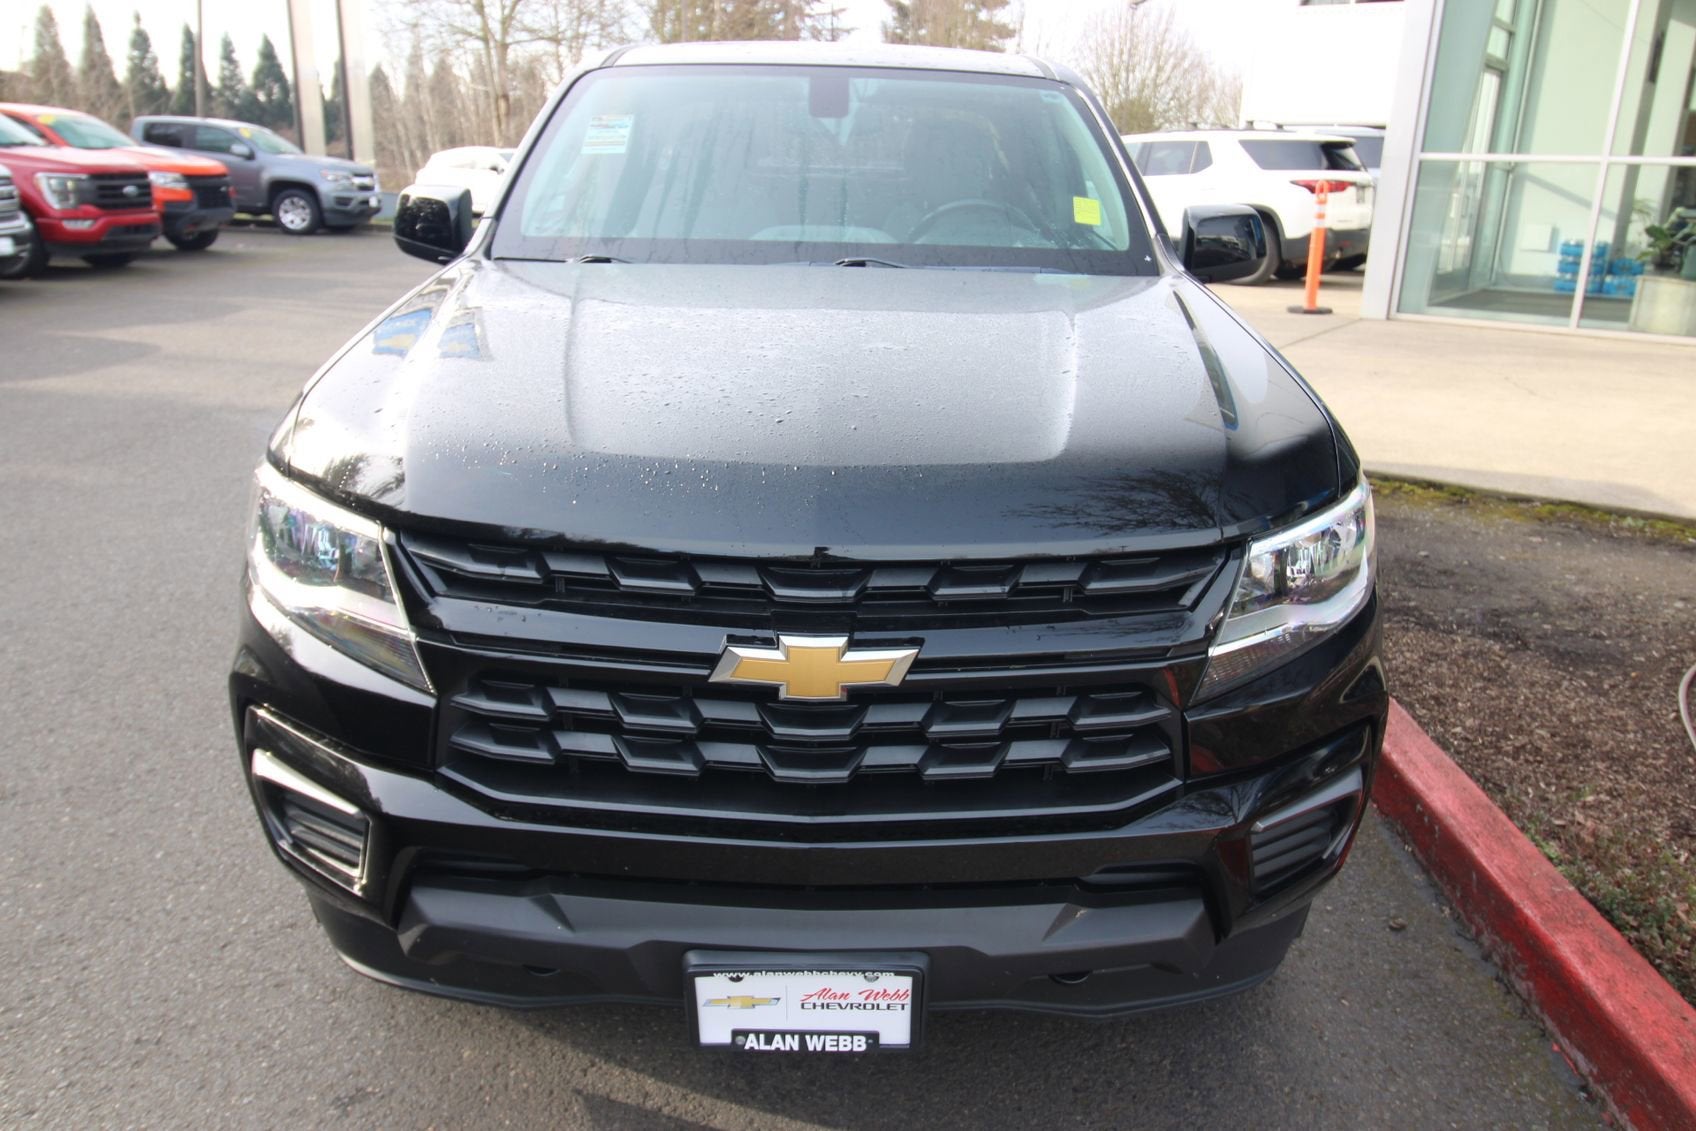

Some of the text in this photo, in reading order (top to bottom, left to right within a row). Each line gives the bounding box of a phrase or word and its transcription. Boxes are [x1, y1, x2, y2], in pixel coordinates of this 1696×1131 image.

[800, 987, 910, 1002] Alan Webb
[800, 1002, 909, 1012] CHEVROLET
[744, 1033, 868, 1052] ALAN WEBB
